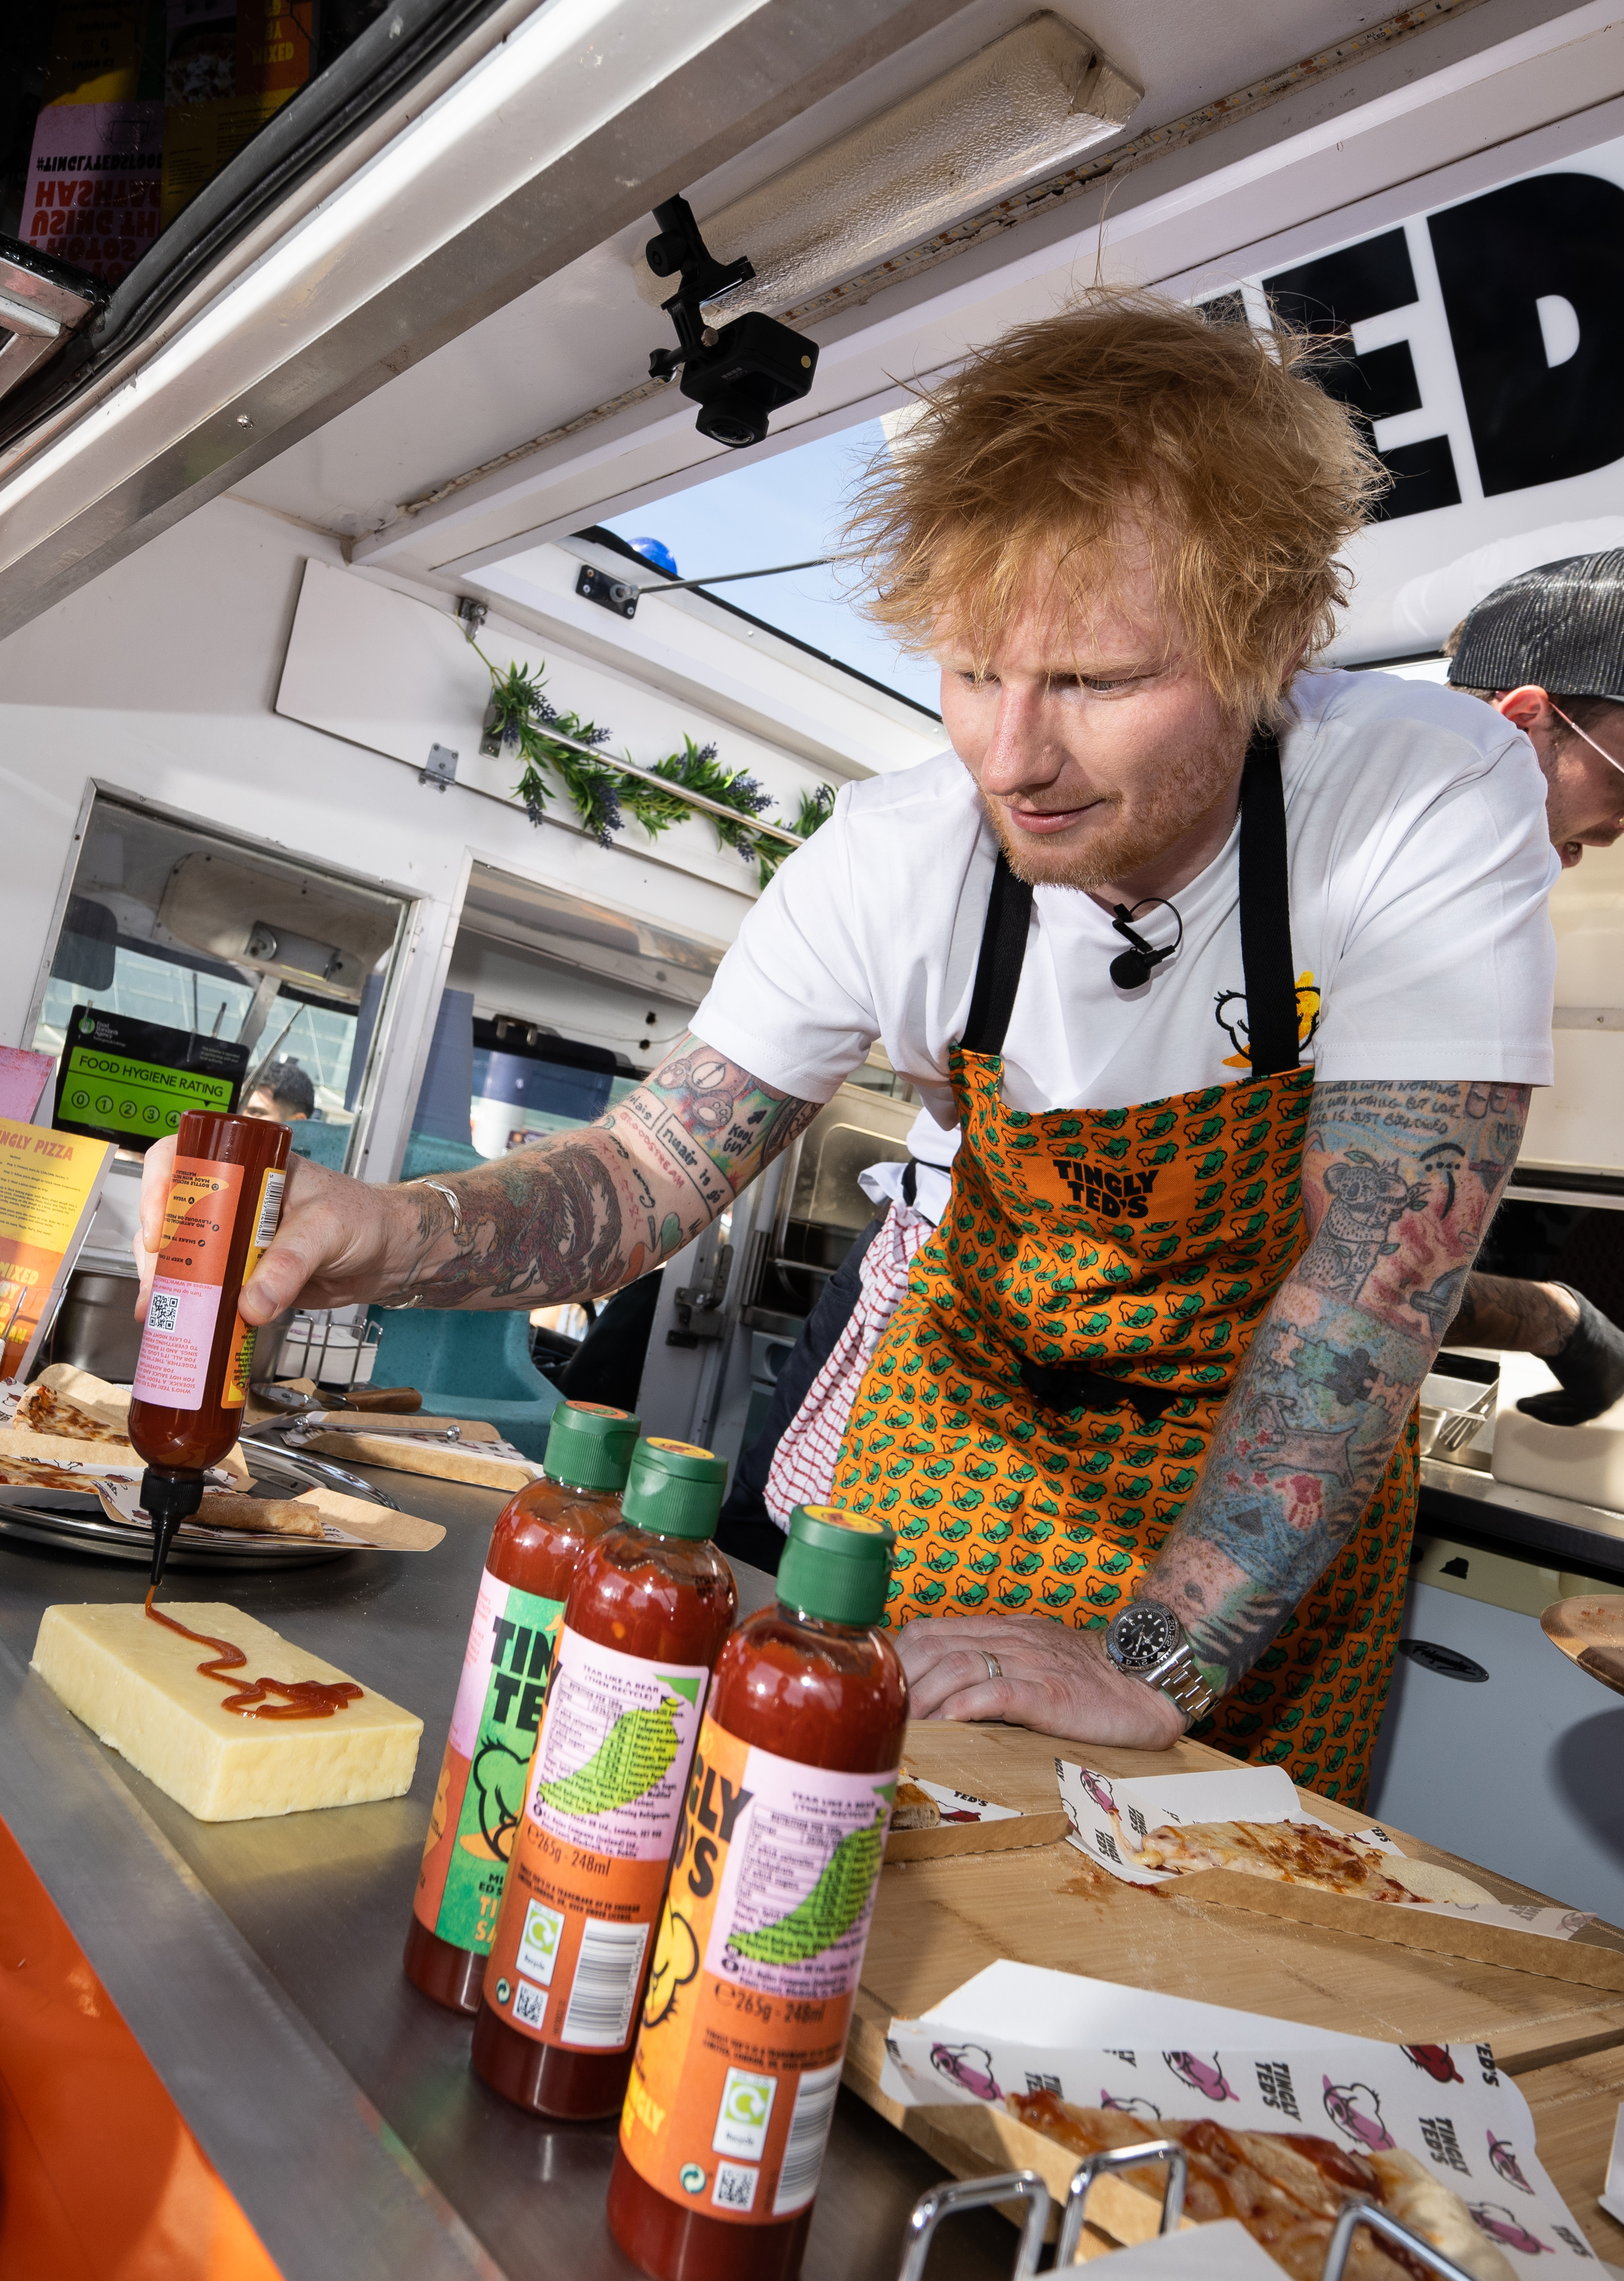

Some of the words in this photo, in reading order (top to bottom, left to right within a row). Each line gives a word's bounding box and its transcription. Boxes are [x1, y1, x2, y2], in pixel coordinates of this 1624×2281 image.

[1373, 30, 1387, 41] LED
[1189, 172, 1624, 529] ED
[94, 1029, 113, 1039] Agency
[95, 1024, 119, 1036] Standards
[96, 1020, 110, 1028] Food
[79, 1054, 121, 1075] FOOD
[122, 1063, 178, 1089] HYGIENE
[178, 1076, 224, 1098] RATING
[75, 1094, 85, 1105] 0
[123, 1103, 133, 1115] 2
[147, 1109, 155, 1120] 3
[169, 1113, 178, 1125] 4
[1405, 1097, 1430, 1110] BUT
[0, 1130, 32, 1151] NGLY
[33, 1139, 74, 1161] PIZZA
[720, 1134, 746, 1160] GUY
[726, 1119, 757, 1150] KOOL
[1053, 1160, 1159, 1198] TINGLY
[263, 1183, 272, 1209] 000157
[1067, 1181, 1148, 1218] TED'S
[184, 1216, 211, 1224] FLAVOURS
[257, 1212, 266, 1238] 149640
[0, 1261, 39, 1286] MIXED
[1, 1281, 20, 1300] BY
[192, 1283, 212, 1291] recipes
[155, 1339, 188, 1349] EVERYTHING
[165, 1359, 197, 1369] TOGETHER,
[1165, 1618, 1177, 1631] 20
[1161, 1633, 1176, 1648] 22
[1139, 1657, 1148, 1666] 2
[582, 1664, 603, 1676] TEAR
[604, 1673, 623, 1683] LIKE
[635, 1682, 659, 1693] BEAR
[584, 1675, 610, 1688] (THEN
[611, 1685, 652, 1702] RECYCLE)
[595, 1694, 606, 1702] PER
[607, 1697, 624, 1711] 100g
[954, 1791, 988, 1807] TED'S
[1128, 1804, 1140, 1834] TED'S
[534, 1833, 565, 1864] 265g
[570, 1848, 612, 1877] 248ml
[1095, 1828, 1110, 1857] TED'S
[1105, 1832, 1124, 1865] TINGLY
[478, 1882, 495, 1893] ED
[783, 1998, 826, 2029] 248ml
[1255, 2060, 1281, 2110] TED'S
[1272, 2060, 1302, 2122] TINGLY
[1418, 2116, 1448, 2167] TED'S
[1435, 2116, 1472, 2178] TINGLY
